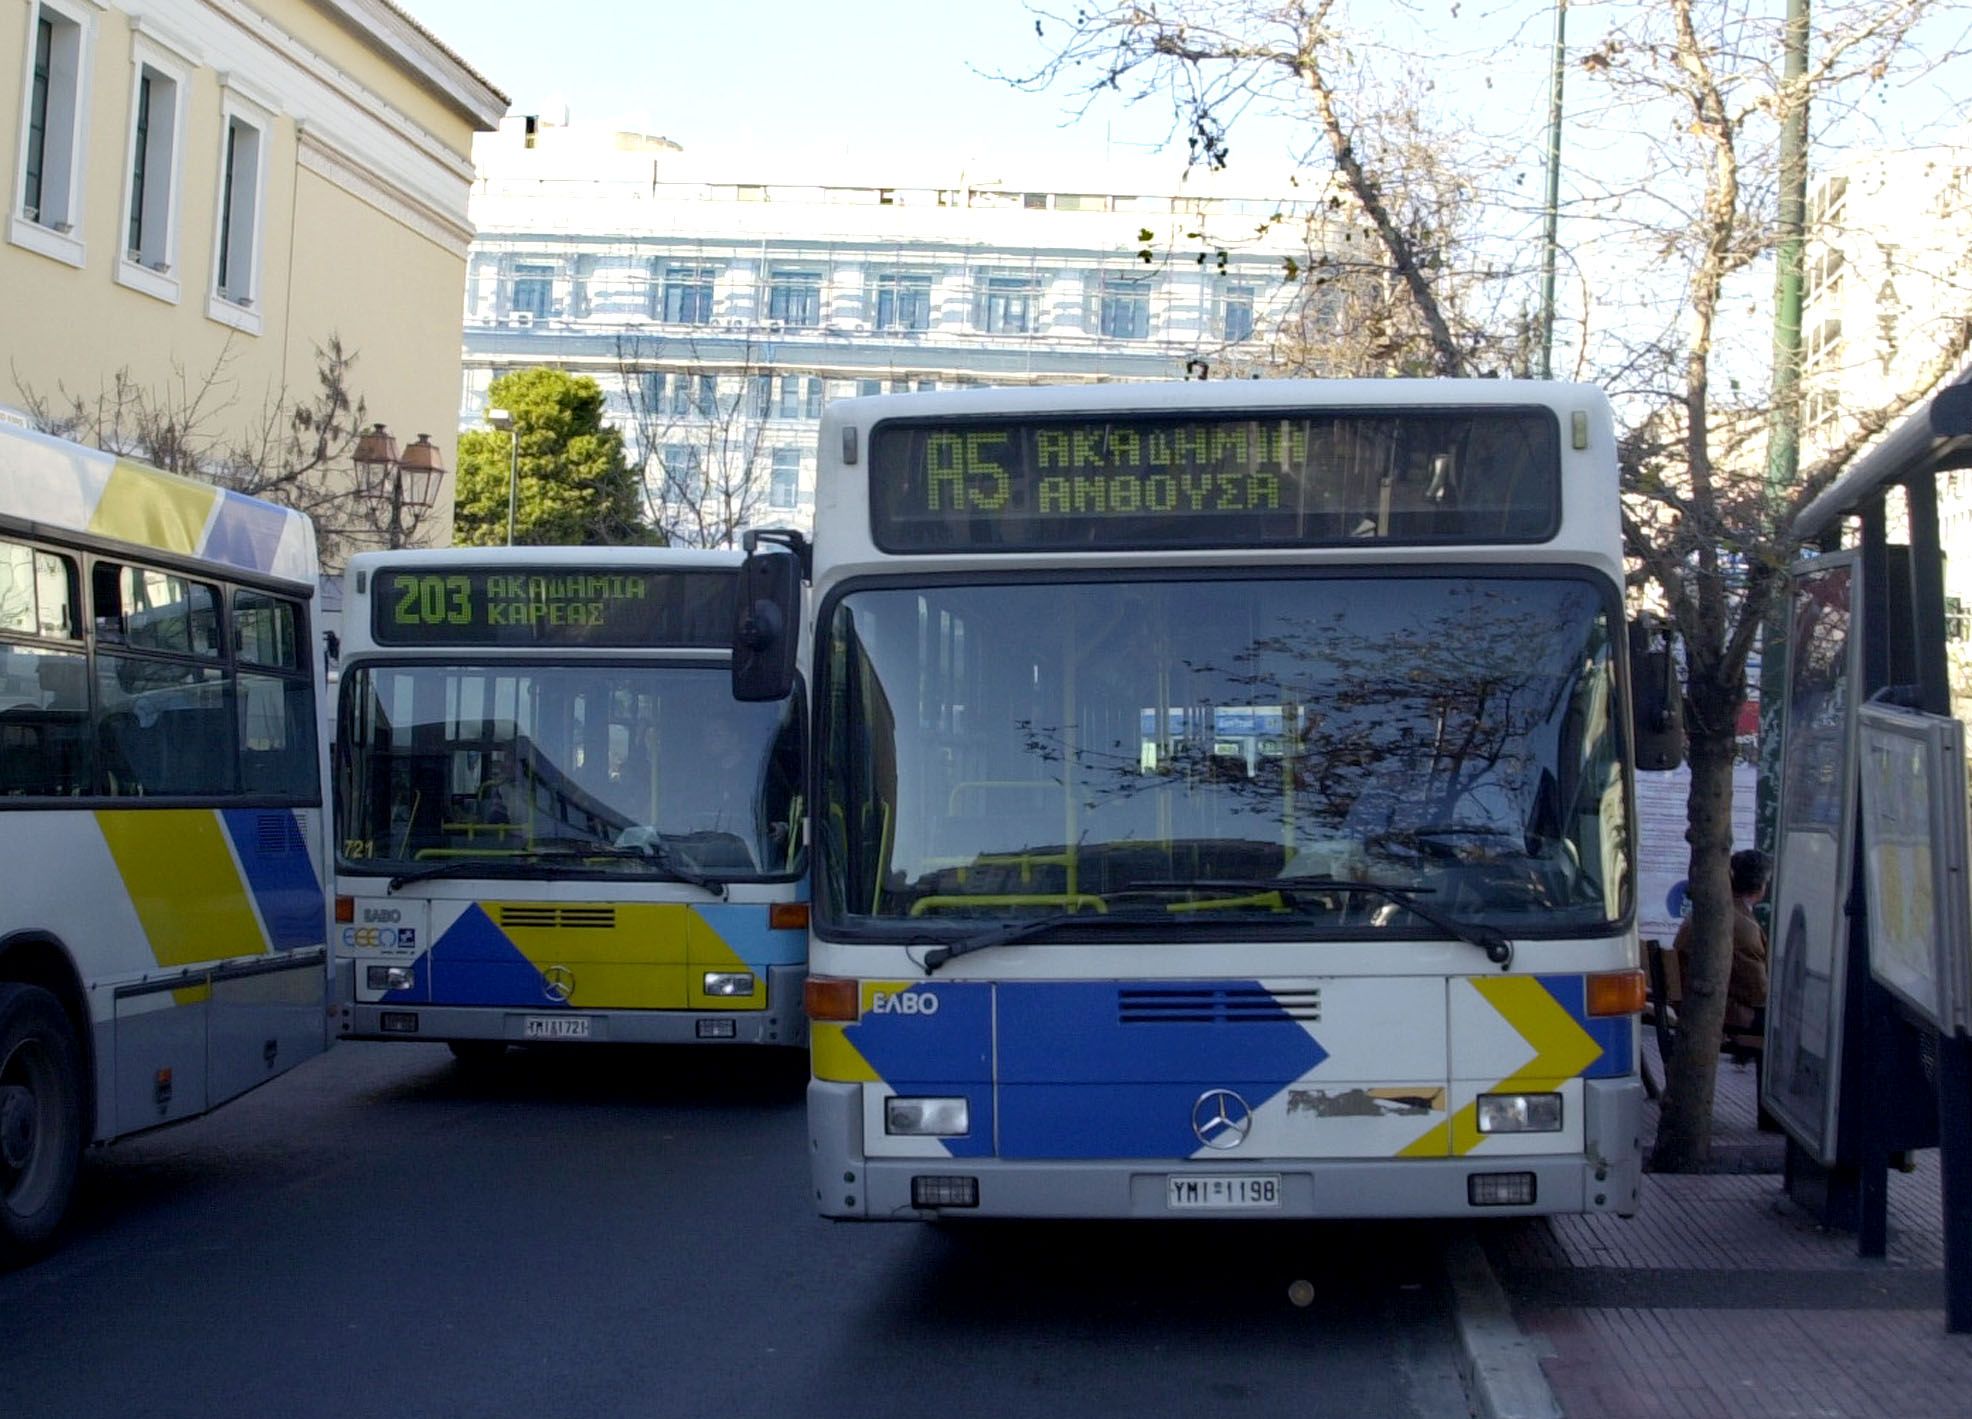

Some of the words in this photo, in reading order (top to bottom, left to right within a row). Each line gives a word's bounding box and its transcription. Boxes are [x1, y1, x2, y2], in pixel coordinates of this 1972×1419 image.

[927, 432, 1009, 510] Α5
[1037, 427, 1307, 468] ΑΚΑΔΗΜΙΑ
[1038, 473, 1279, 513] ΑΝΘΟΥΣΑ
[394, 575, 472, 625] 203
[487, 576, 646, 599] ΑΚΑΔΗΜΙΑ
[487, 602, 604, 625] ΚΑΡΕΑΣ
